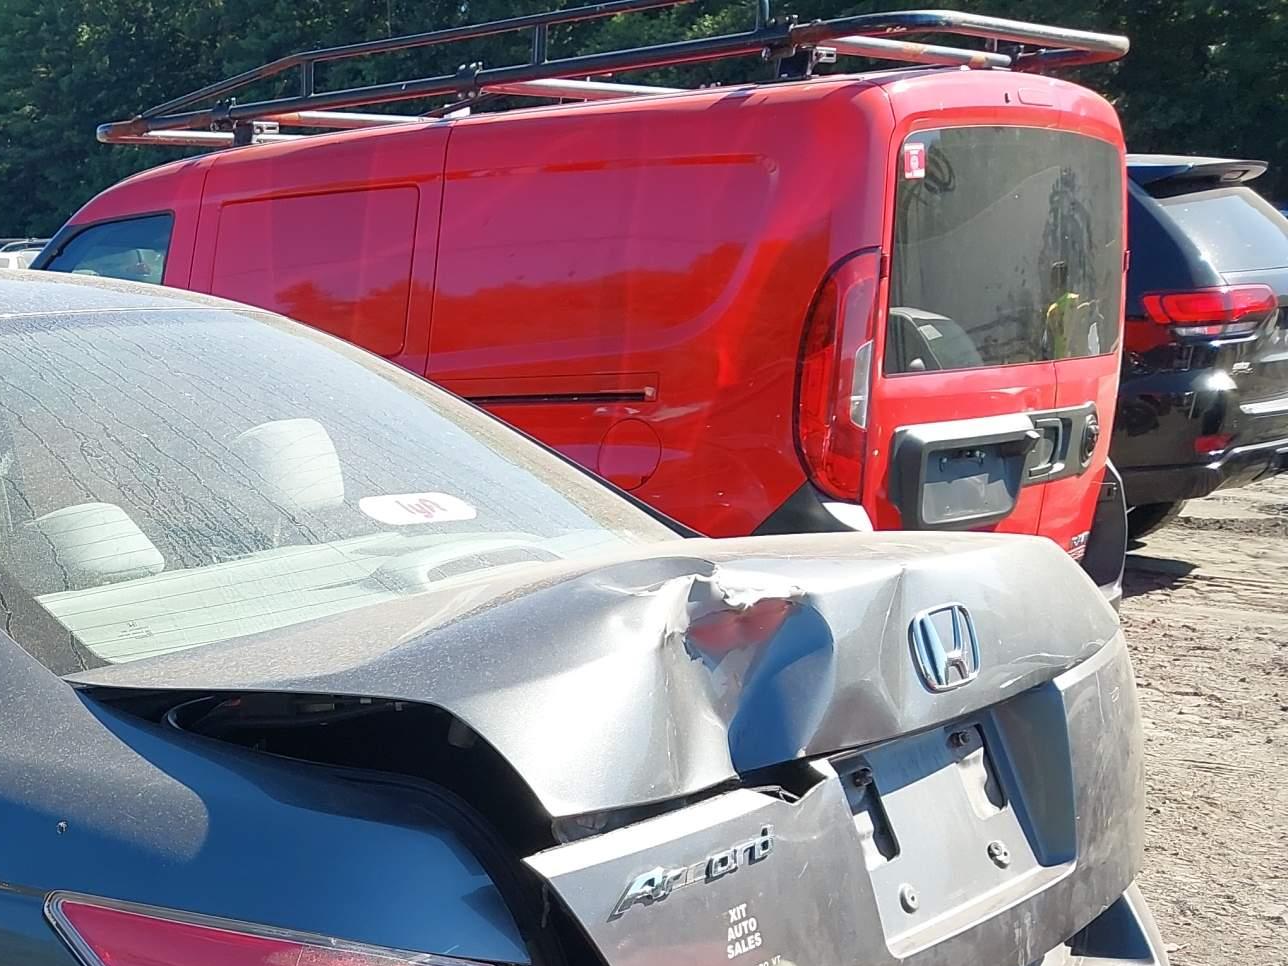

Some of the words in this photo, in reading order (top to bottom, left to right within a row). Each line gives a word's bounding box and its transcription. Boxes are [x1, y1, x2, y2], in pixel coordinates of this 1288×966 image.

[727, 917, 758, 942] AUTO
[726, 932, 763, 960] SALES
[771, 955, 782, 966] VT
